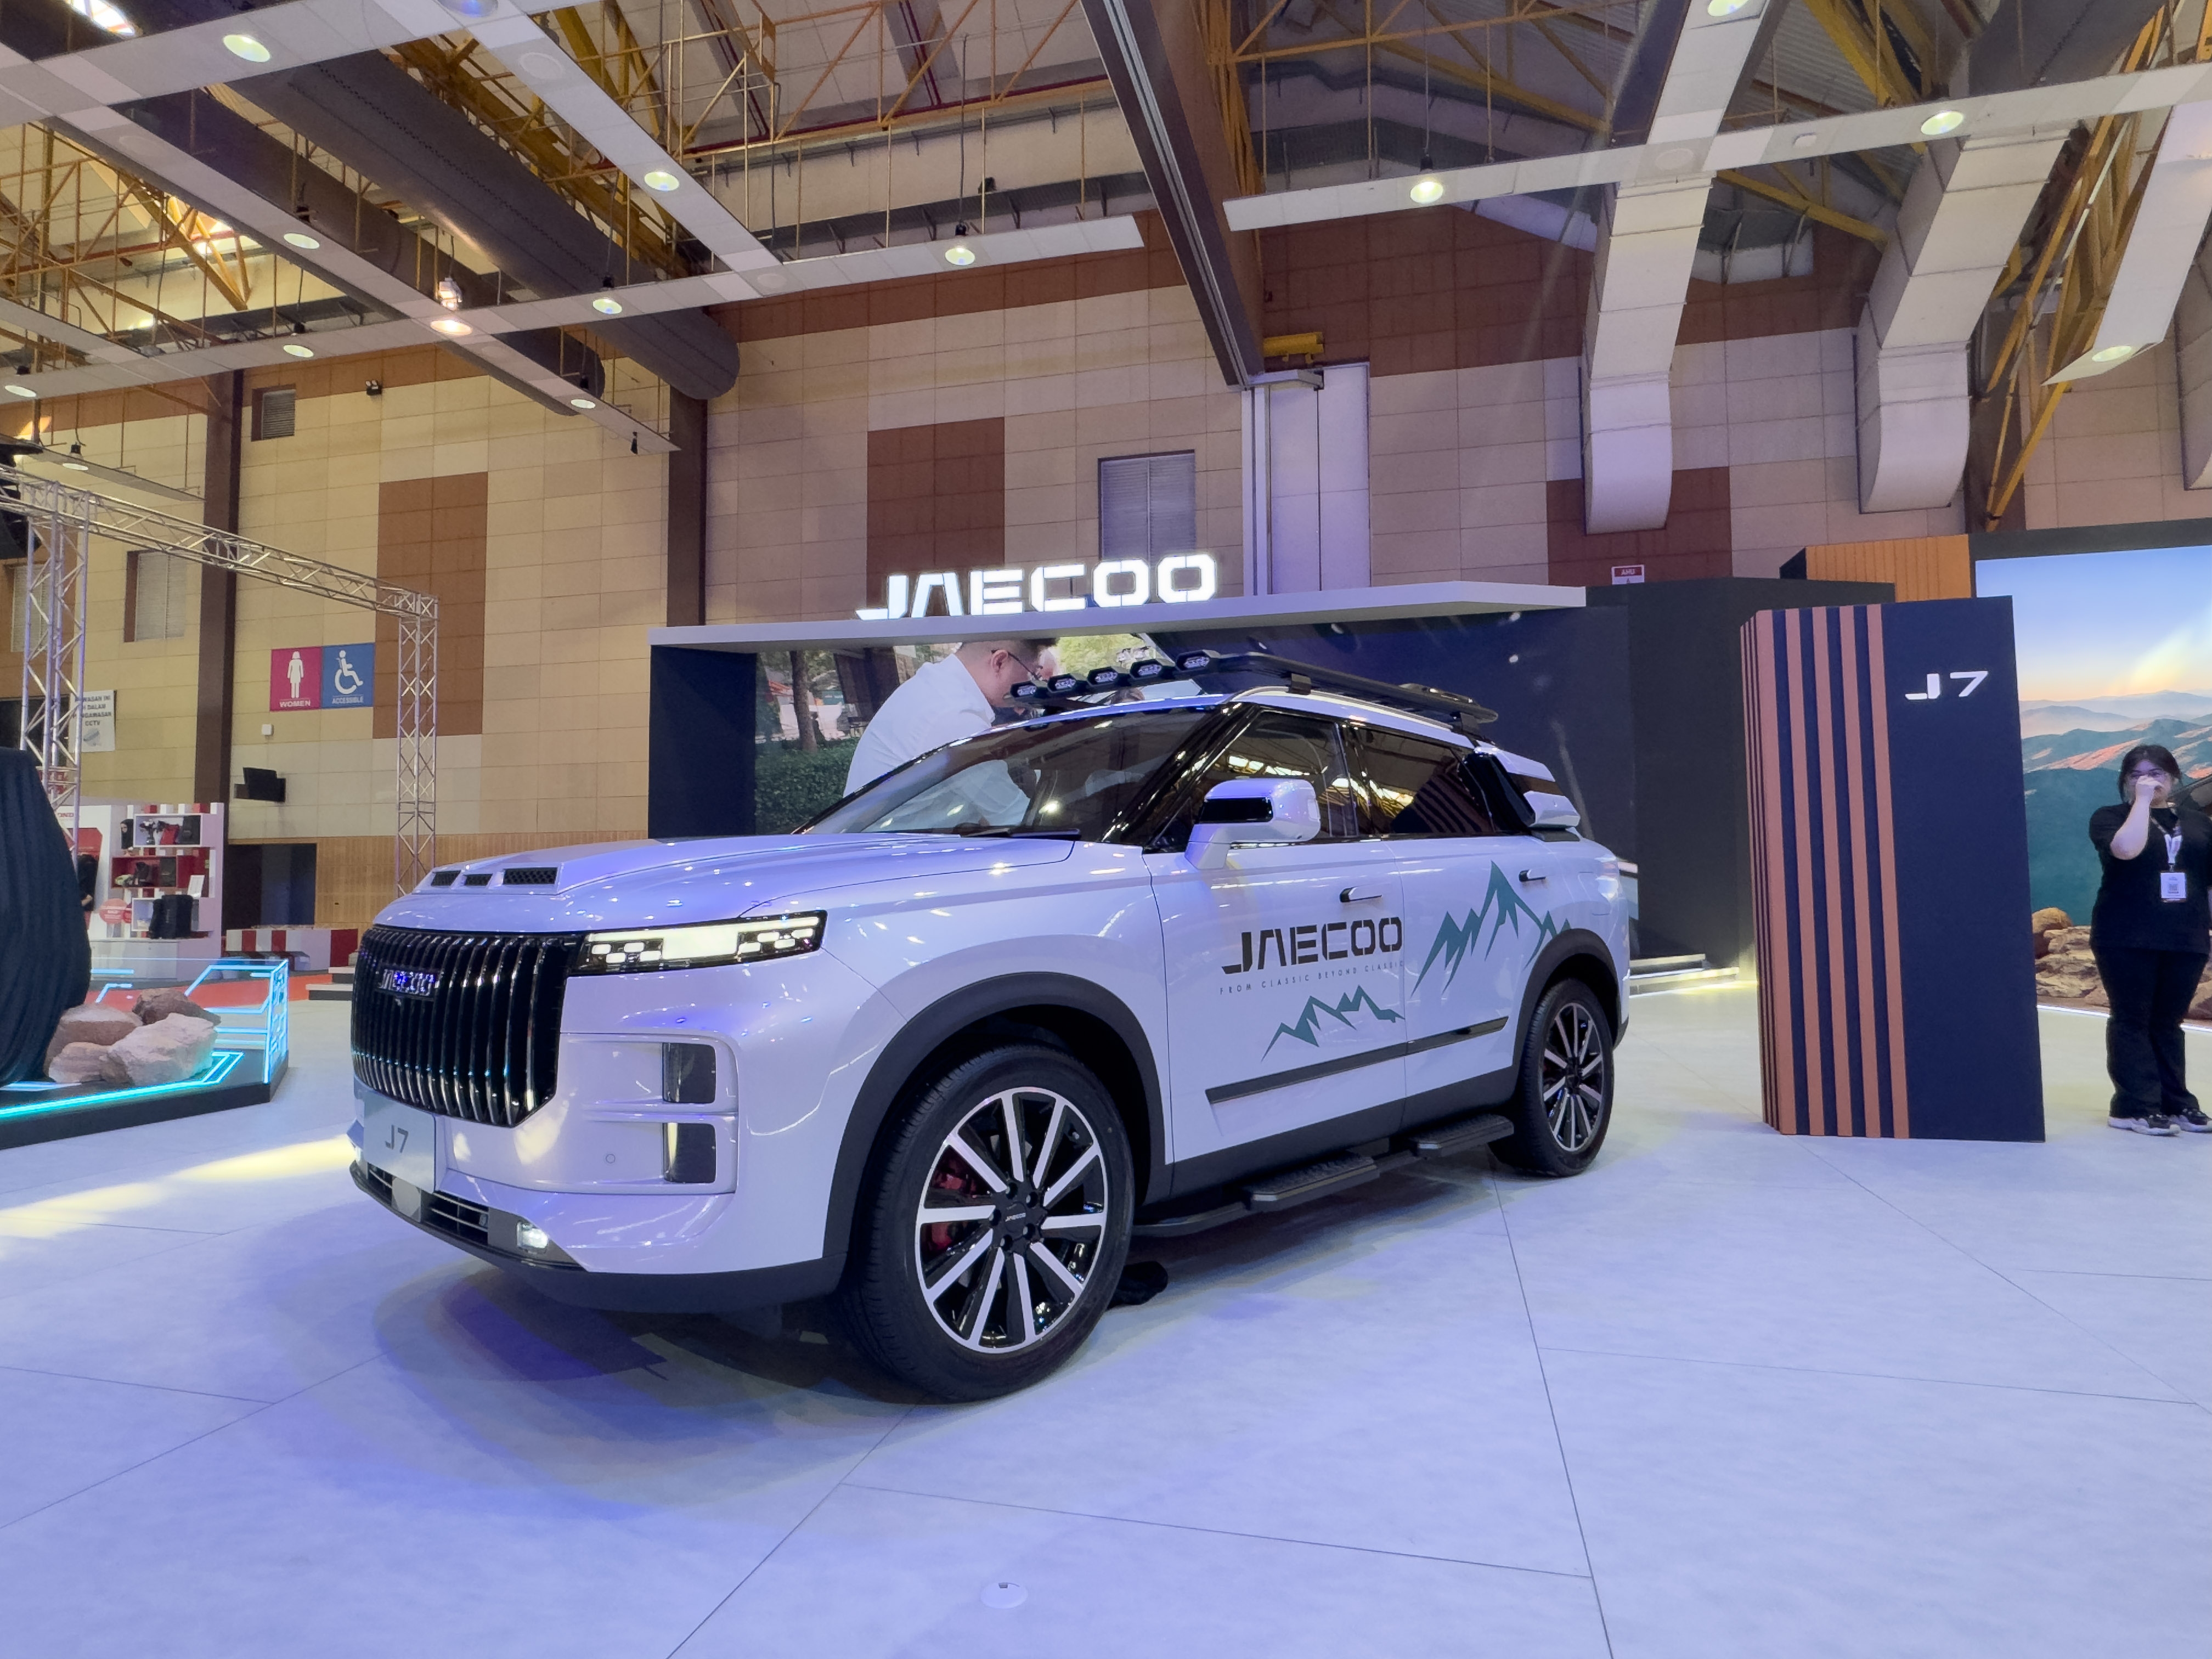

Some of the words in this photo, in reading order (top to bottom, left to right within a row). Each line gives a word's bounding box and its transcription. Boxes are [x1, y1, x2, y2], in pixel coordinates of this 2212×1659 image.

[855, 553, 1216, 621] JAECOO
[1905, 670, 1988, 700] J7
[1221, 916, 1402, 974] JAECOO
[1220, 983, 1252, 995] FROM
[1261, 974, 1310, 989] CLASSIC
[1318, 967, 1357, 980] BEYOND
[1364, 960, 1404, 972] CLASSIC
[385, 1125, 409, 1153] J7
